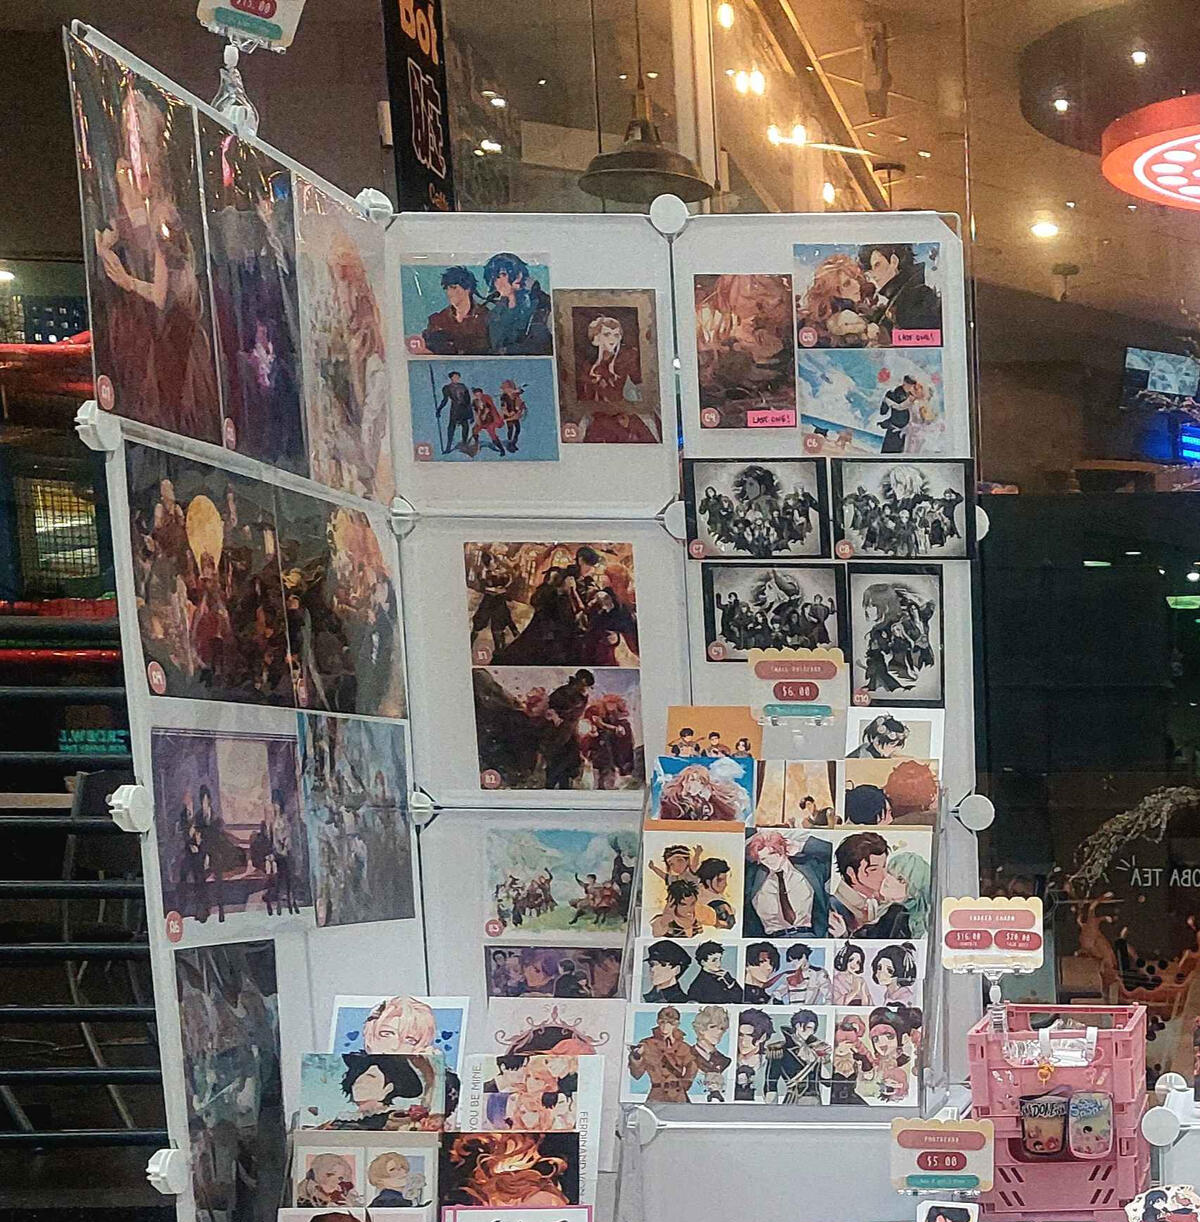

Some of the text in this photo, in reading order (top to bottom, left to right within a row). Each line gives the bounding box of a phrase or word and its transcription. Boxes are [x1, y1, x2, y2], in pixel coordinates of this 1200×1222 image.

[806, 438, 818, 447] C6
[782, 685, 810, 697] $6.00
[470, 1094, 480, 1109] BE
[469, 1111, 479, 1131] YOU
[926, 1155, 958, 1167] $5.00
